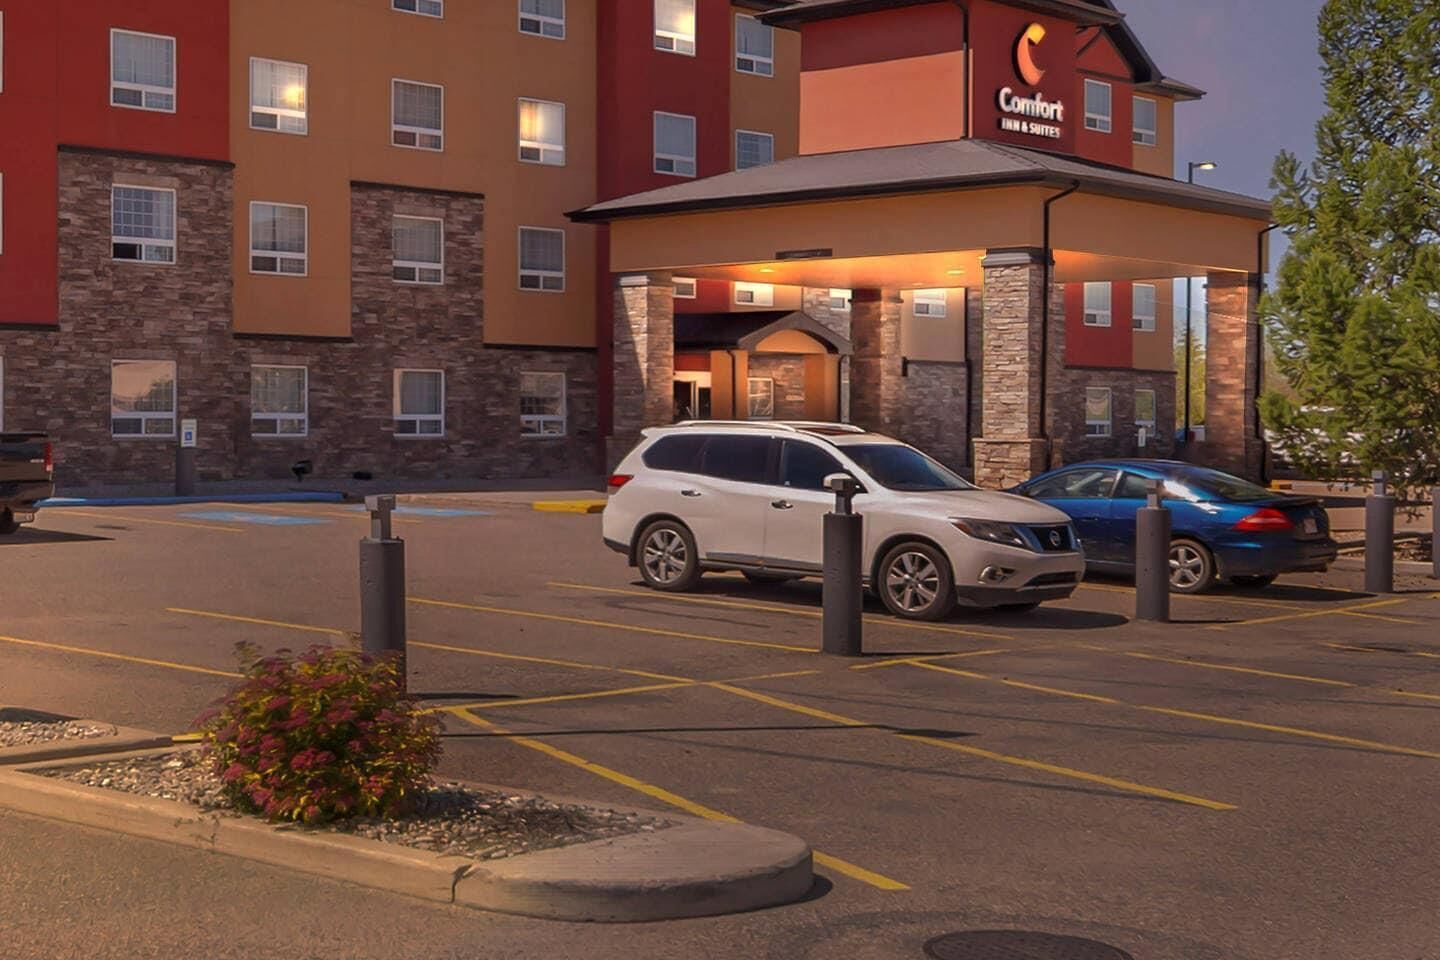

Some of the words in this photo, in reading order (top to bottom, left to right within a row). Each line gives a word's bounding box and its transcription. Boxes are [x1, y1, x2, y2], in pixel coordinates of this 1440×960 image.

[999, 87, 1063, 121] Comfort
[1001, 118, 1020, 131] INN
[1021, 121, 1028, 133] &
[1029, 122, 1060, 138] SUITES
